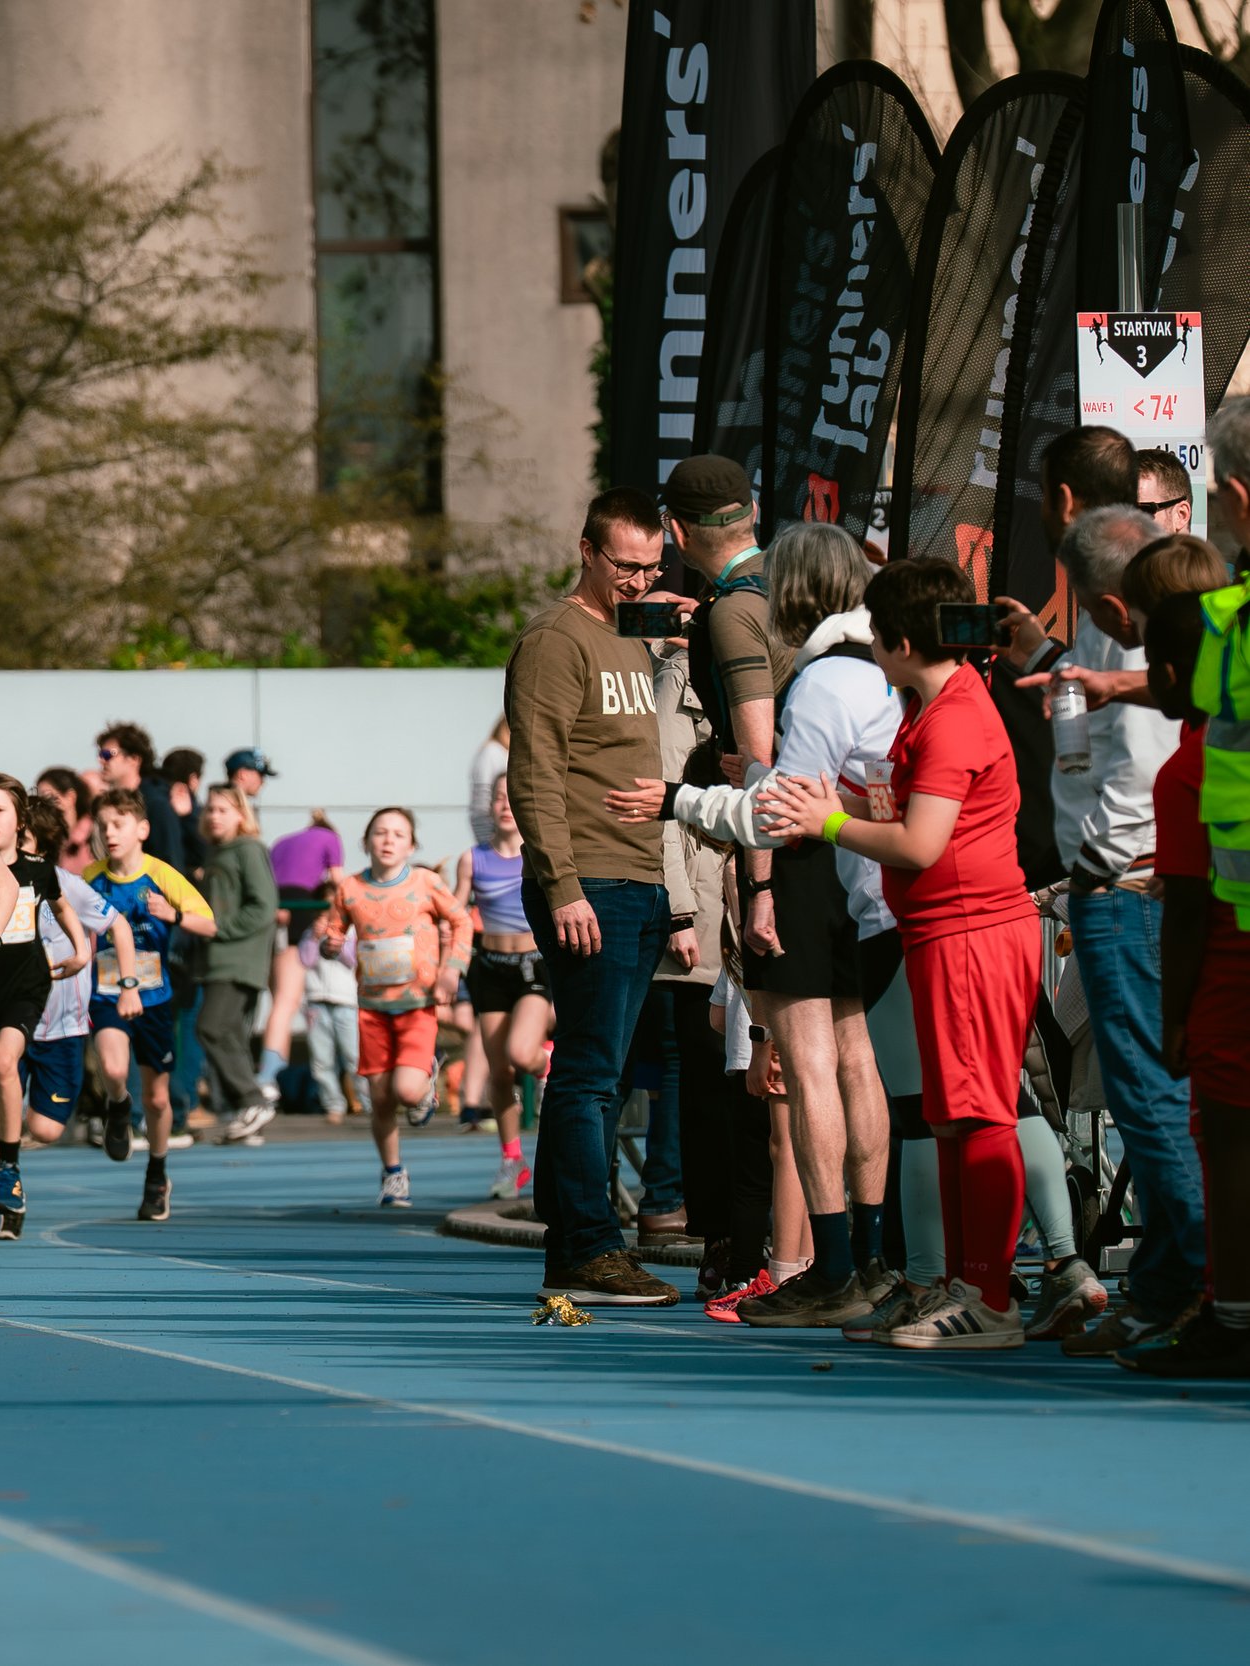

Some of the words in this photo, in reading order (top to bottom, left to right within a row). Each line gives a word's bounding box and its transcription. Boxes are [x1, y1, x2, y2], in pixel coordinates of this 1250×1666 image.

[1113, 321, 1172, 337] STARTVAK
[1136, 345, 1147, 368] 3
[1083, 402, 1107, 413] WAVE
[1109, 402, 1114, 413] 1
[872, 507, 885, 527] 2
